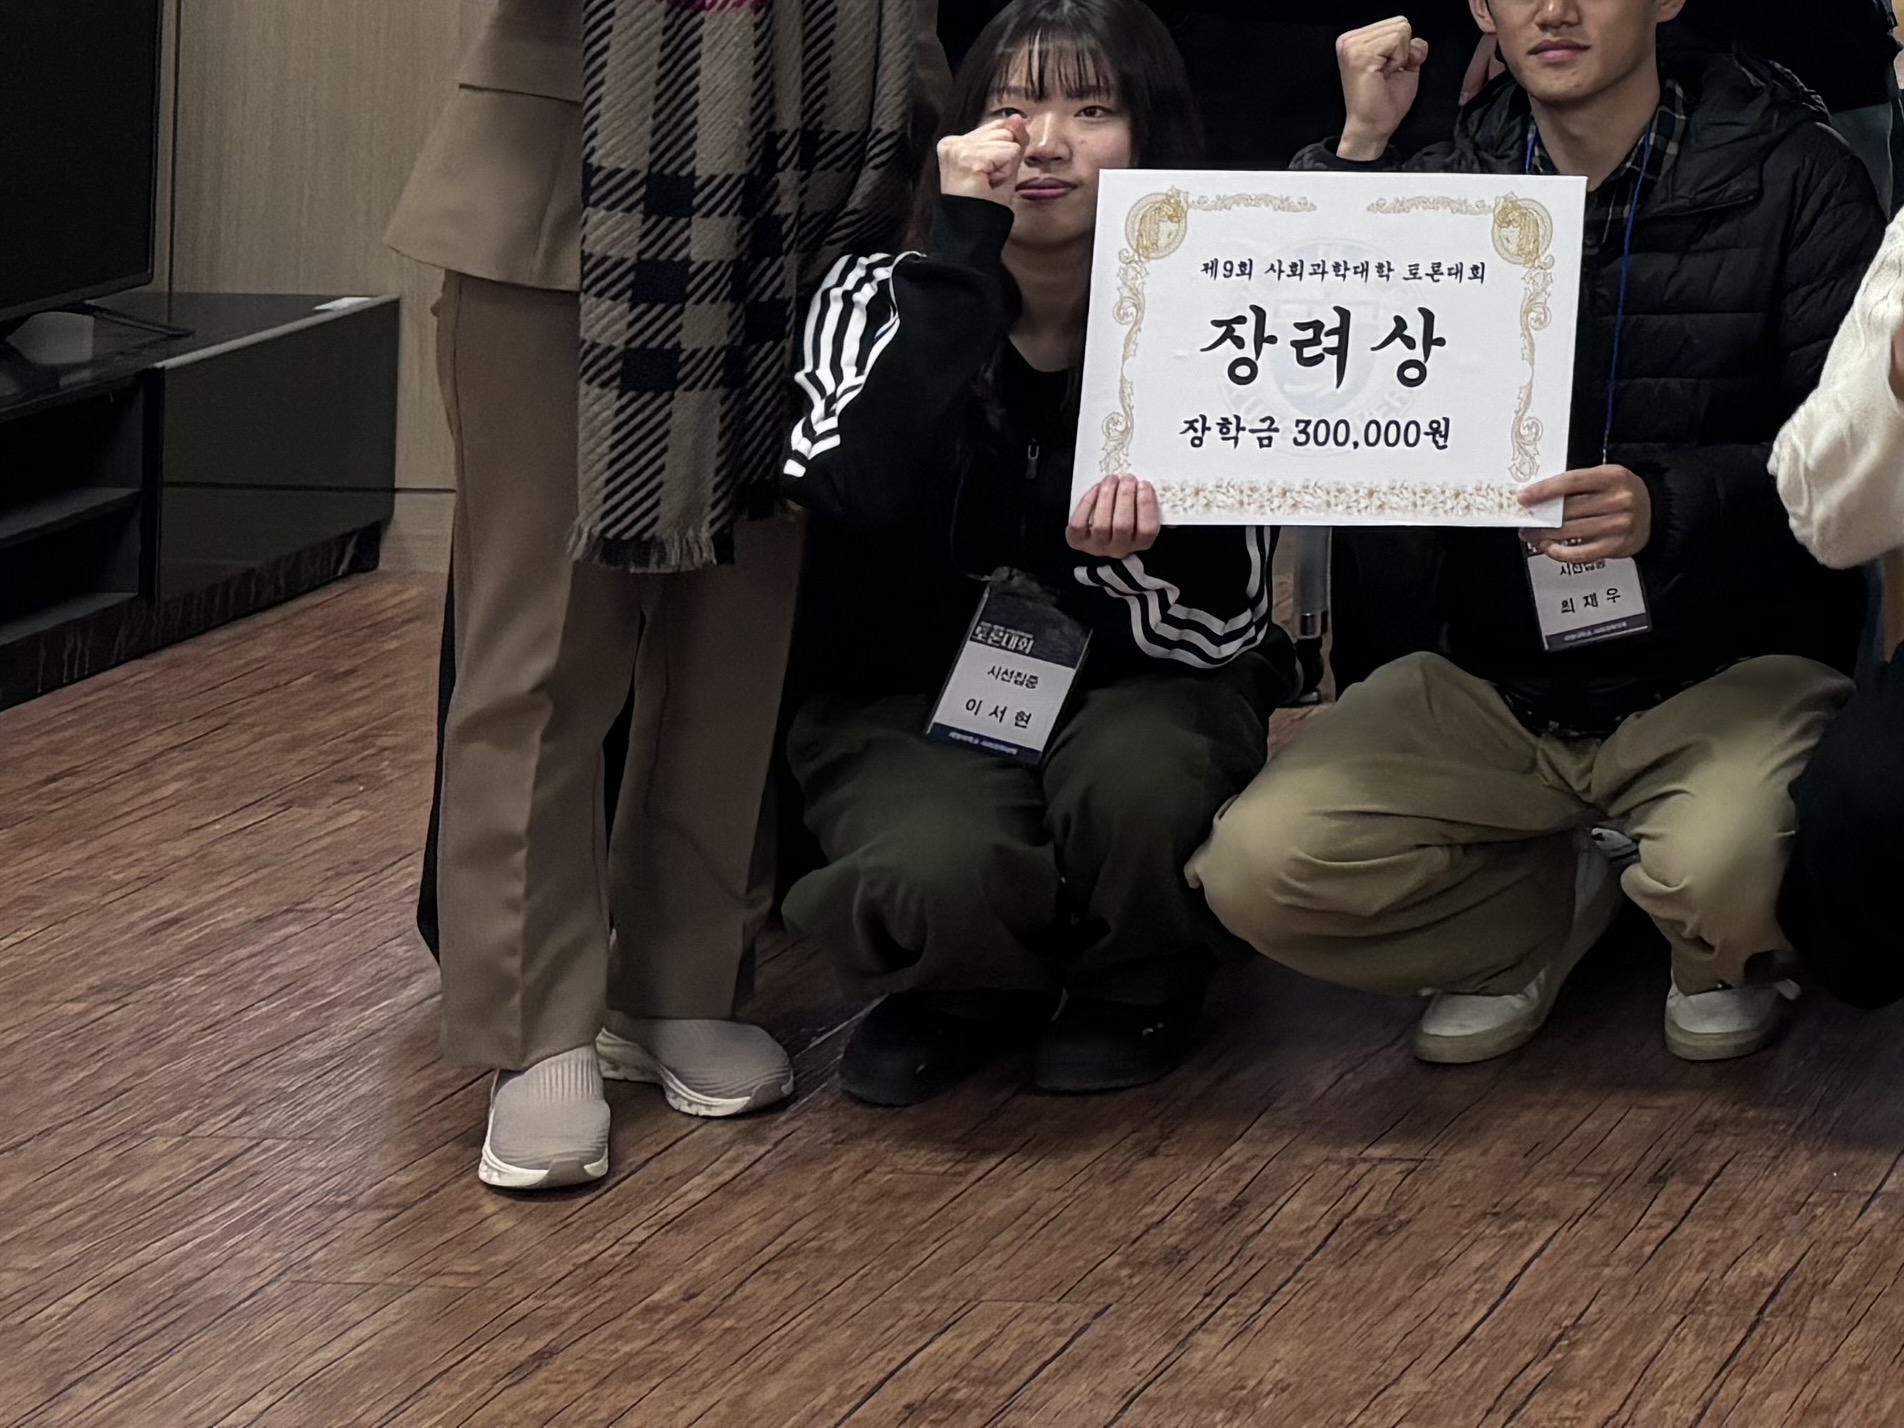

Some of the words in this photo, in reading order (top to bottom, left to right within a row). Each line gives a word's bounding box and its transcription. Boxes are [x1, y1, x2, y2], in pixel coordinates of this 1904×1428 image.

[1201, 258, 1253, 280] 제9회
[1265, 259, 1394, 282] 사회과학대학
[1403, 262, 1485, 284] 토론대회
[1200, 305, 1446, 388] 장려상
[1180, 414, 1279, 448] 장학금
[1293, 417, 1449, 450] 300,000원
[972, 625, 1035, 654] 토론대회
